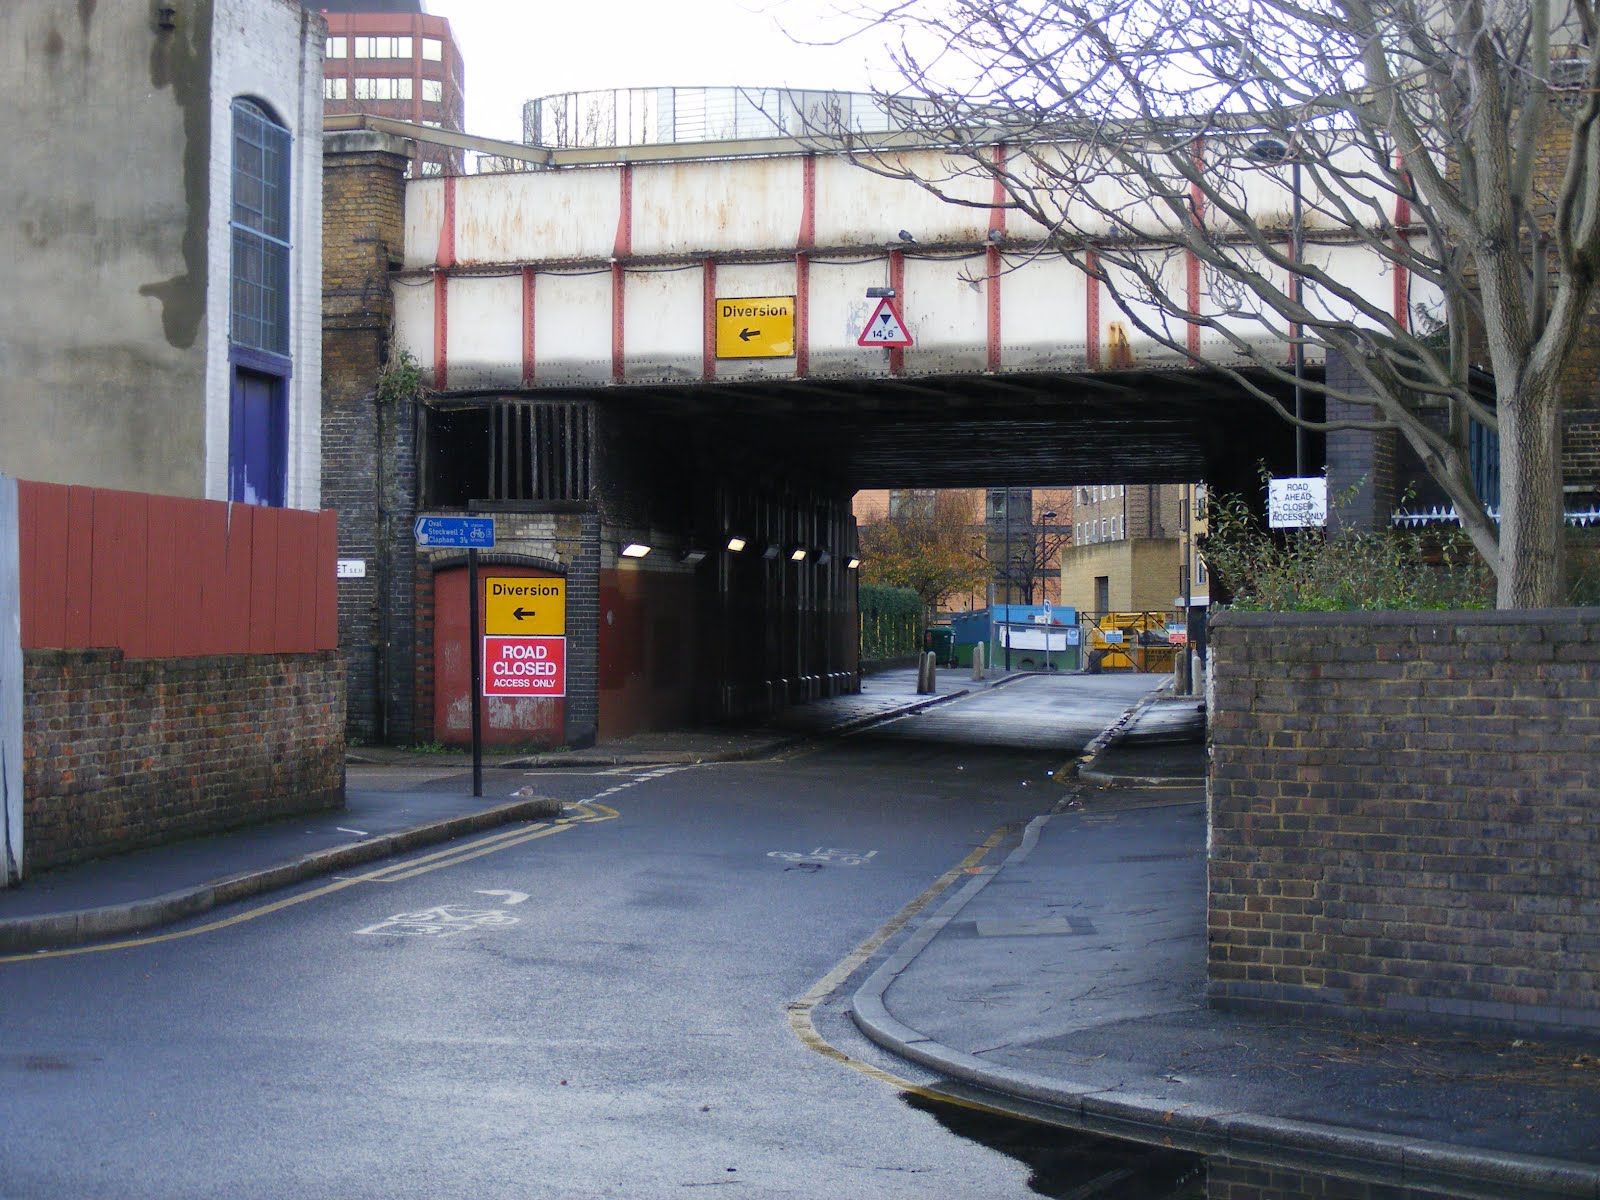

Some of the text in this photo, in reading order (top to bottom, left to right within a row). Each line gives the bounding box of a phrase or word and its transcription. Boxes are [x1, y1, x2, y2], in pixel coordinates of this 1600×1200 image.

[723, 304, 787, 318] Diversion
[1287, 483, 1308, 491] ROAD
[1285, 493, 1311, 501] AHEAD
[1283, 503, 1313, 511] CLOSE
[1272, 513, 1302, 521] ACCESS
[428, 528, 458, 536] Stockwell
[492, 583, 559, 596] Diversion
[502, 645, 547, 659] ROAD
[493, 661, 557, 676] CLOSED
[493, 679, 556, 688] ACCESS ONLY
